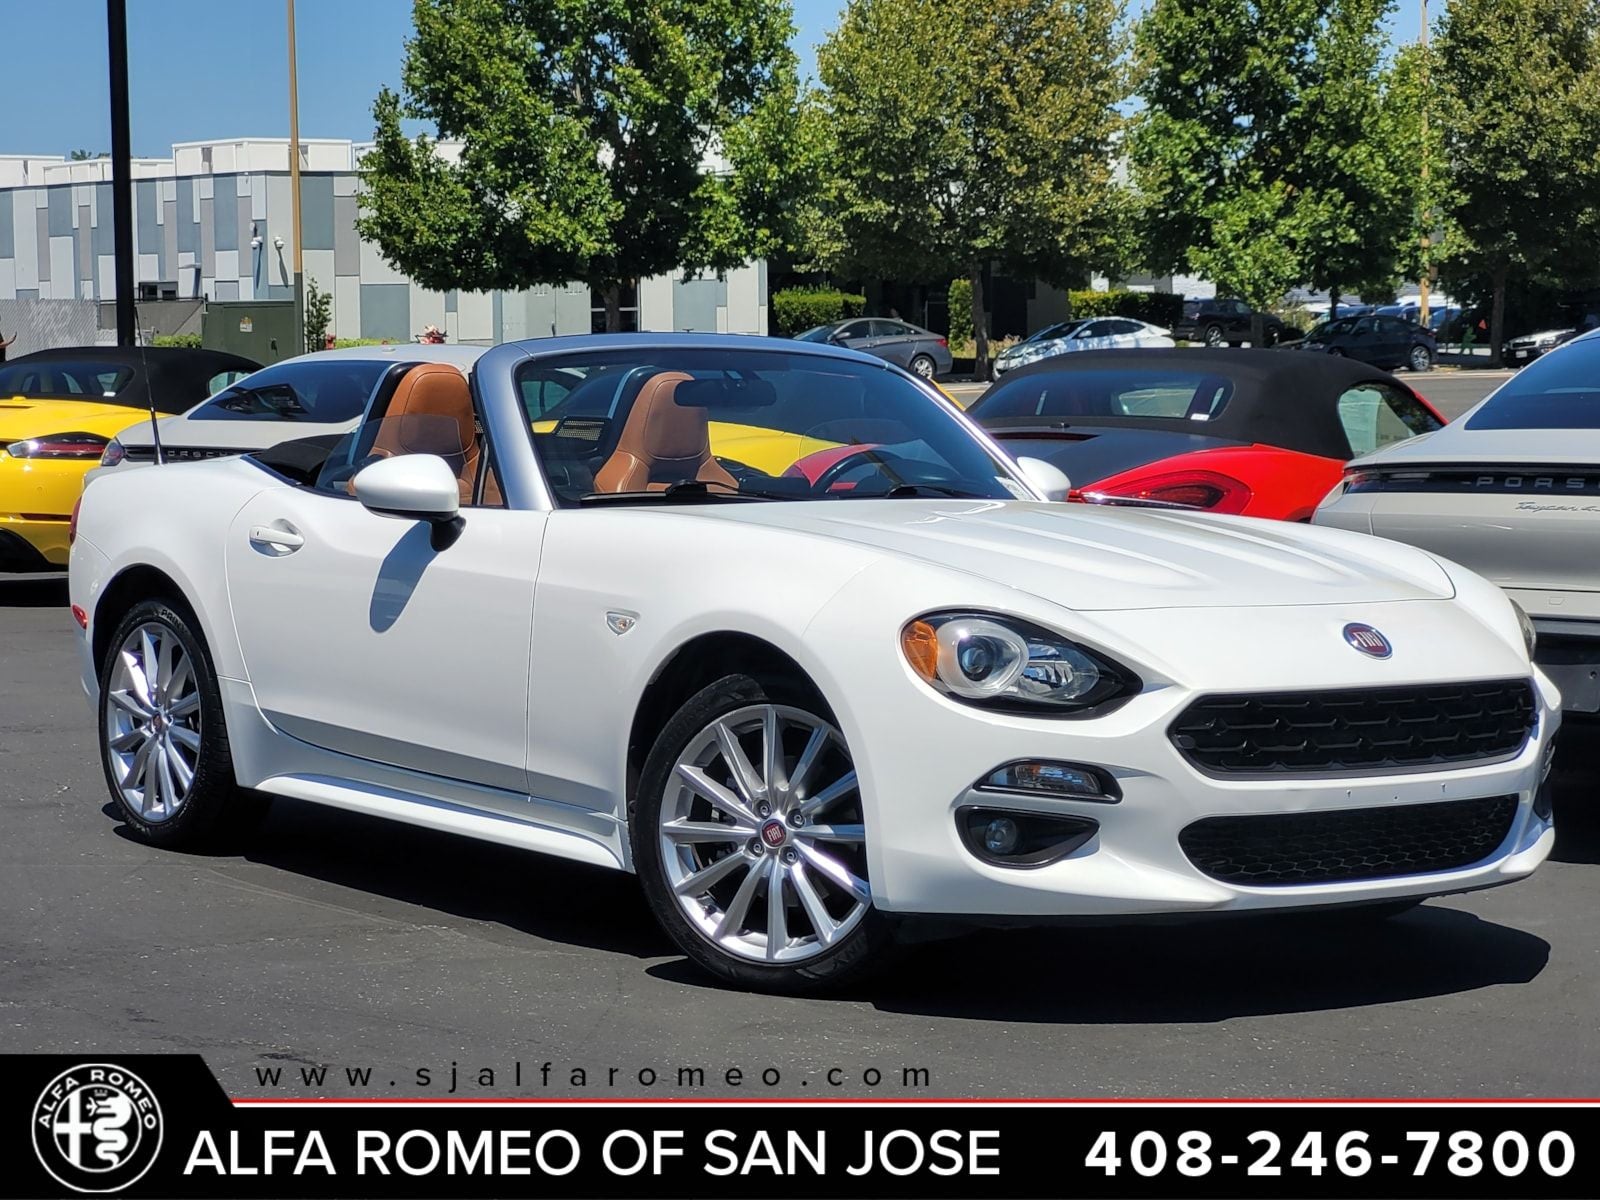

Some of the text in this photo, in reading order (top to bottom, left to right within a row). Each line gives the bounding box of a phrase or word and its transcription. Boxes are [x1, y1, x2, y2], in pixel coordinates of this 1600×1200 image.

[1475, 476, 1600, 489] PORS
[1352, 631, 1384, 648] FIAT
[766, 825, 782, 842] FIAT
